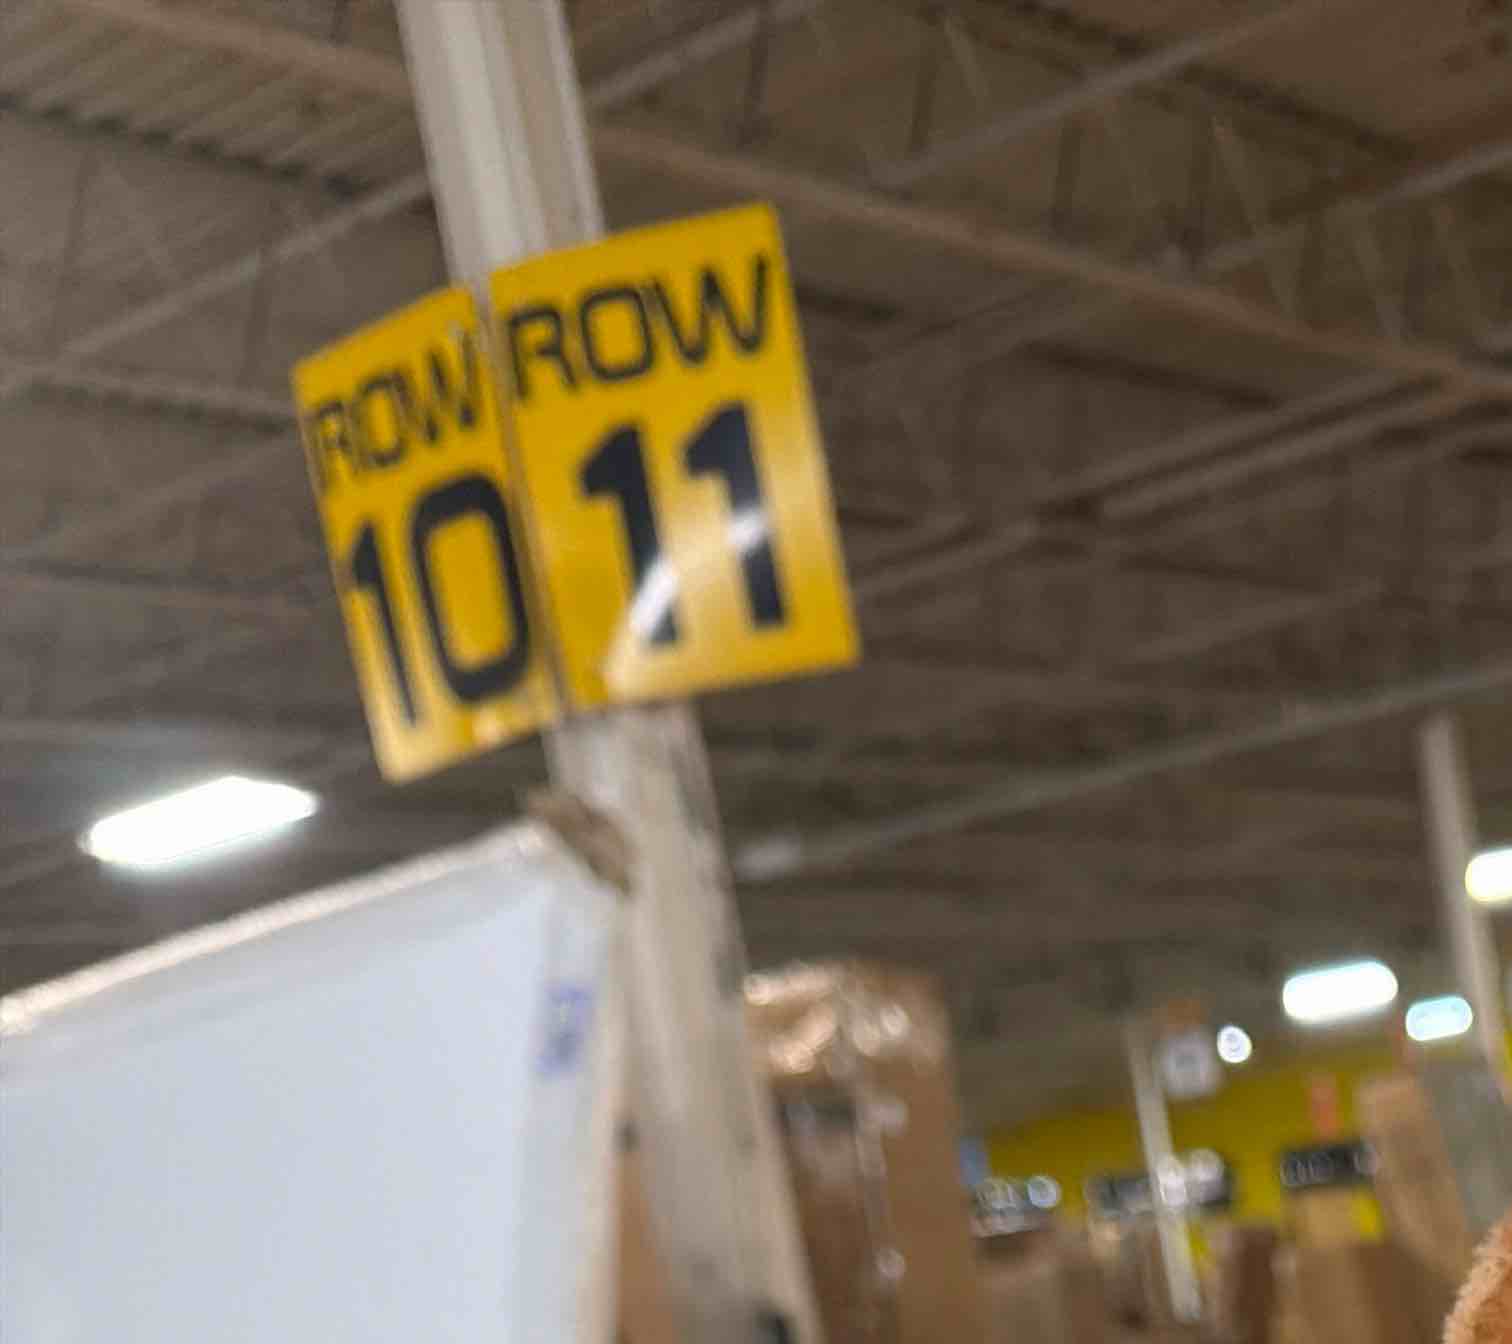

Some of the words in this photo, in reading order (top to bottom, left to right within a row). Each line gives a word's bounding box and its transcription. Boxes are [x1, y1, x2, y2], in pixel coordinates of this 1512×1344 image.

[312, 326, 476, 488] ROW
[507, 254, 770, 400] ROW
[348, 470, 530, 728] 10
[578, 402, 785, 645] 11
